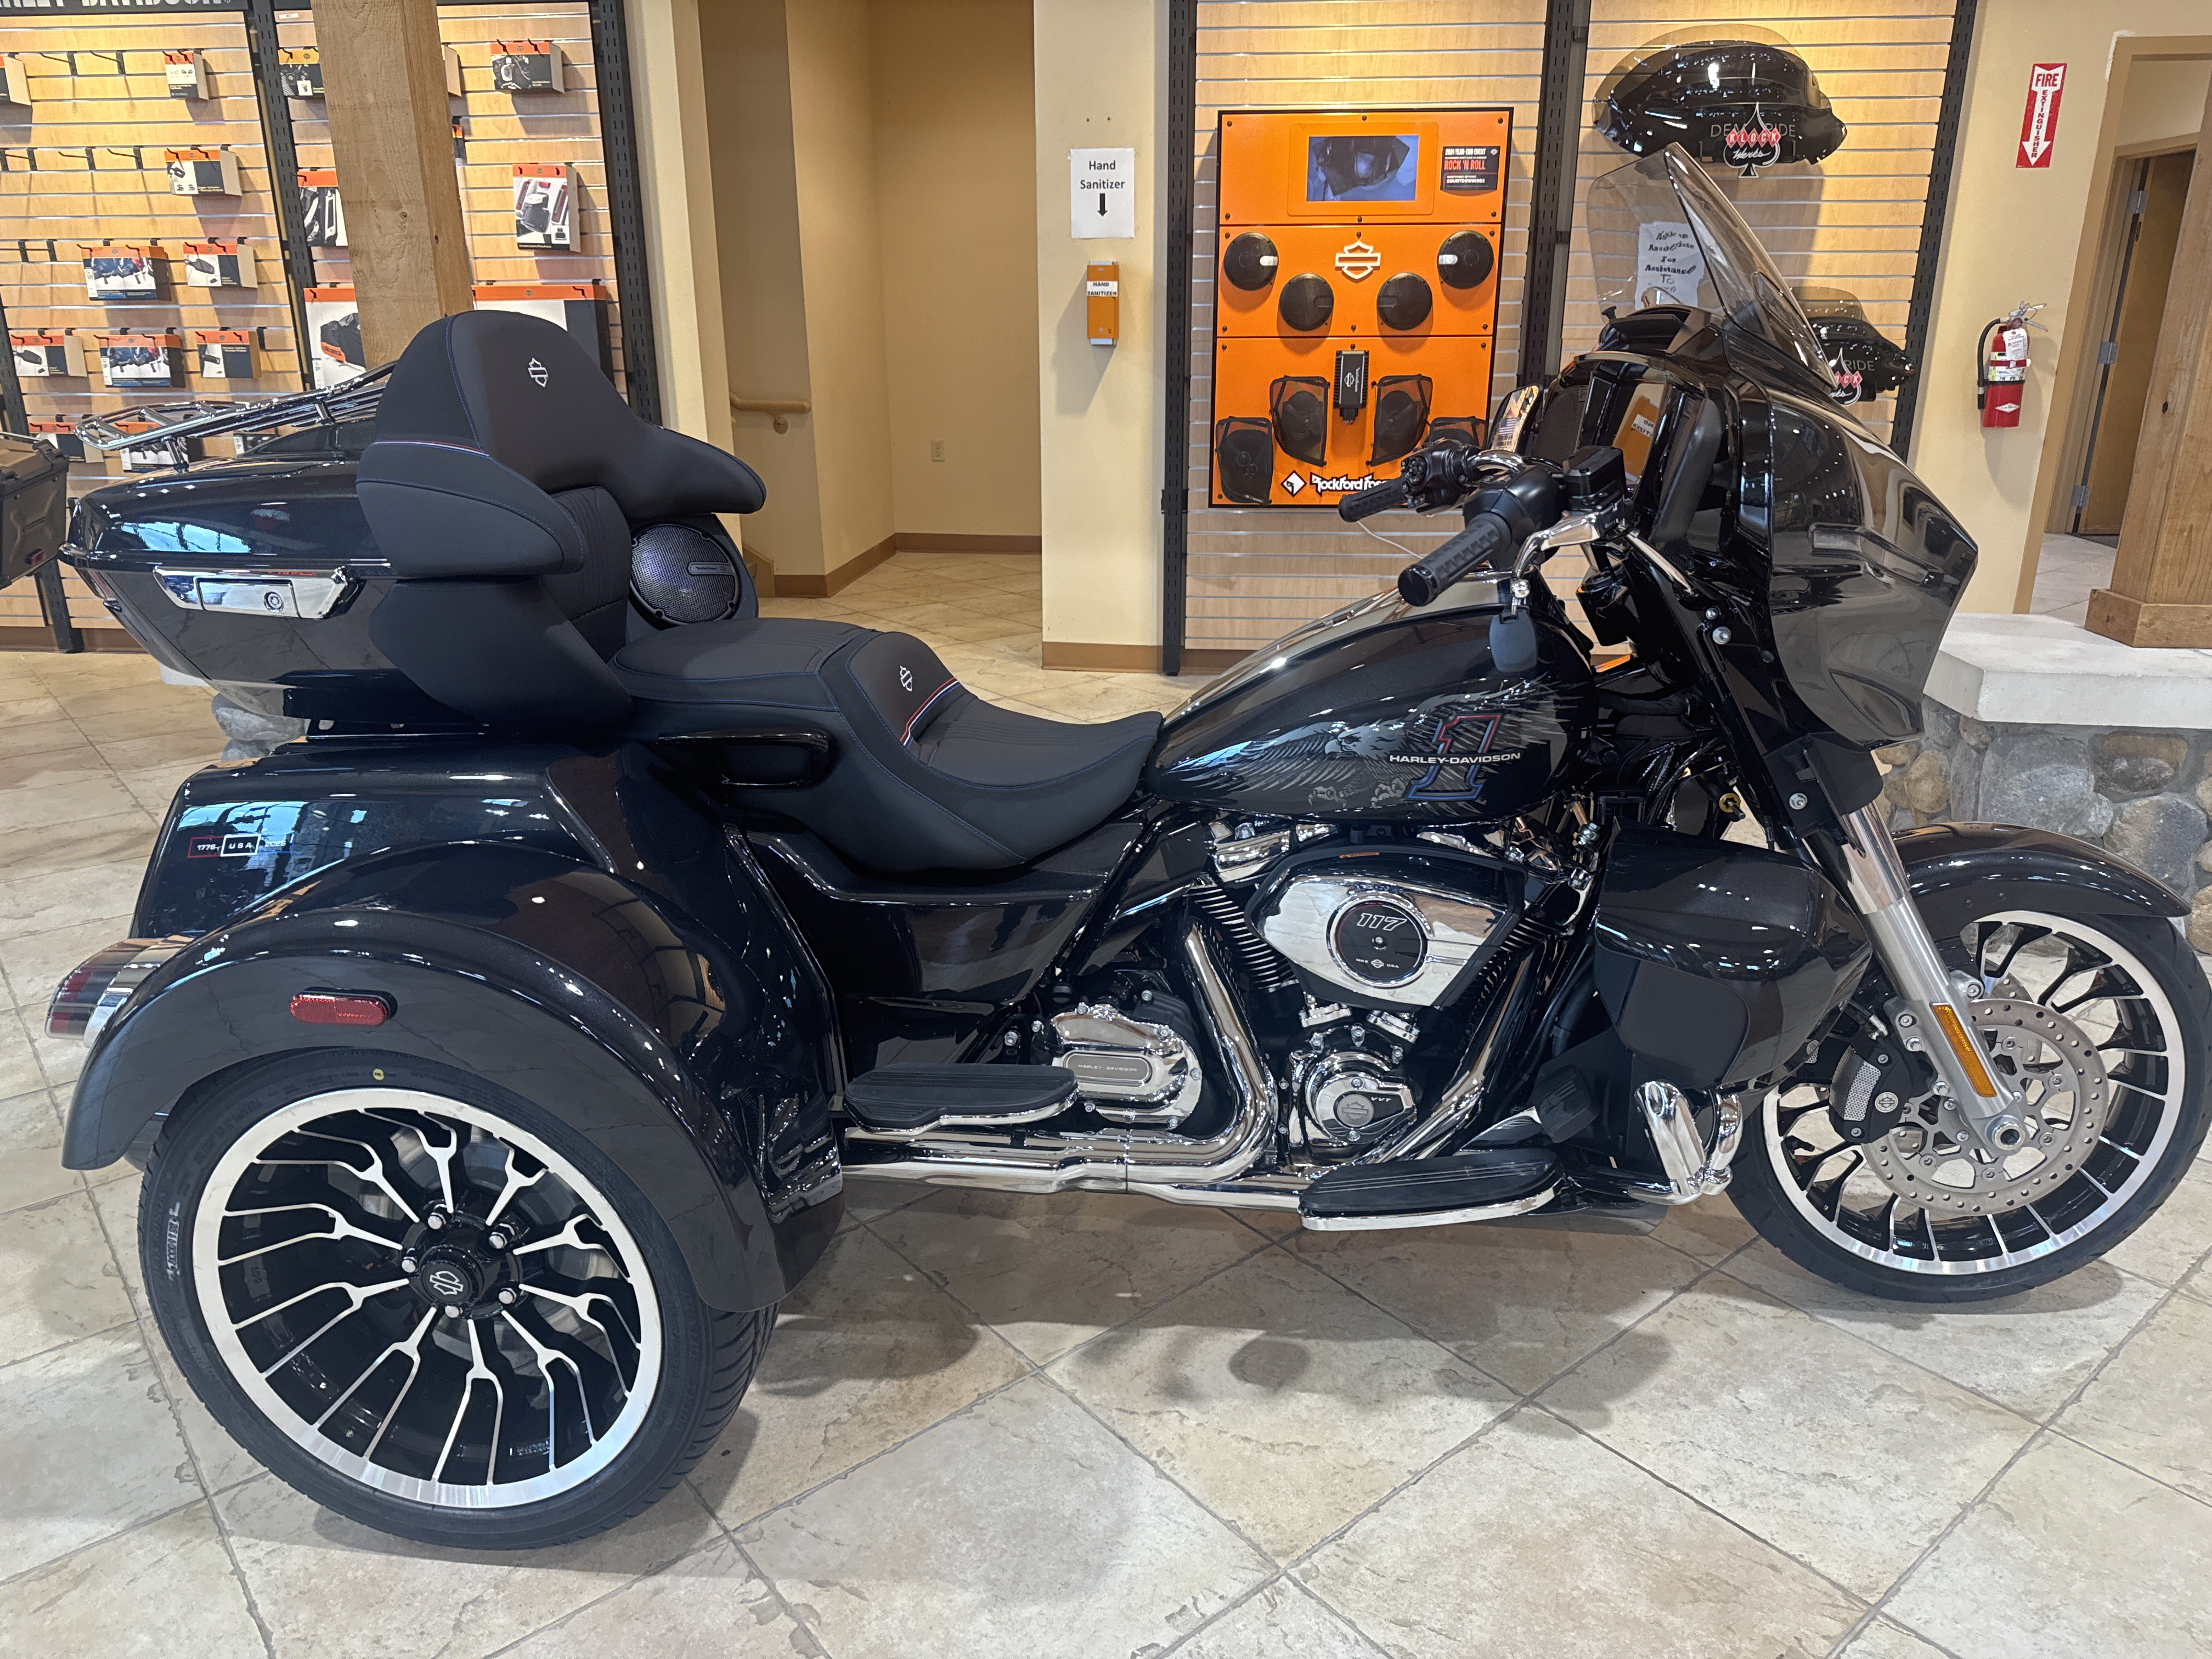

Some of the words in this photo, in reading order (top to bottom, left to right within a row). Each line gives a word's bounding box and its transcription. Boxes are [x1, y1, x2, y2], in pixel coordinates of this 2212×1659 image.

[2035, 73, 2059, 87] FIRE
[2030, 89, 2049, 158] EXTINGUISHER
[1729, 133, 1777, 145] KLOCK
[1733, 147, 1771, 160] Werks
[1089, 160, 1116, 170] Hand
[1444, 160, 1462, 170] ROCK
[1470, 160, 1486, 170] ROLL
[1080, 179, 1125, 189] Sanitizer
[1844, 359, 1875, 371] RIDE
[1835, 375, 1859, 383] OCK
[1311, 473, 1363, 494] Rockford
[1389, 752, 1521, 764] HARLEY-DAVIDSON
[228, 842, 252, 850] USA
[1356, 912, 1408, 931] 117
